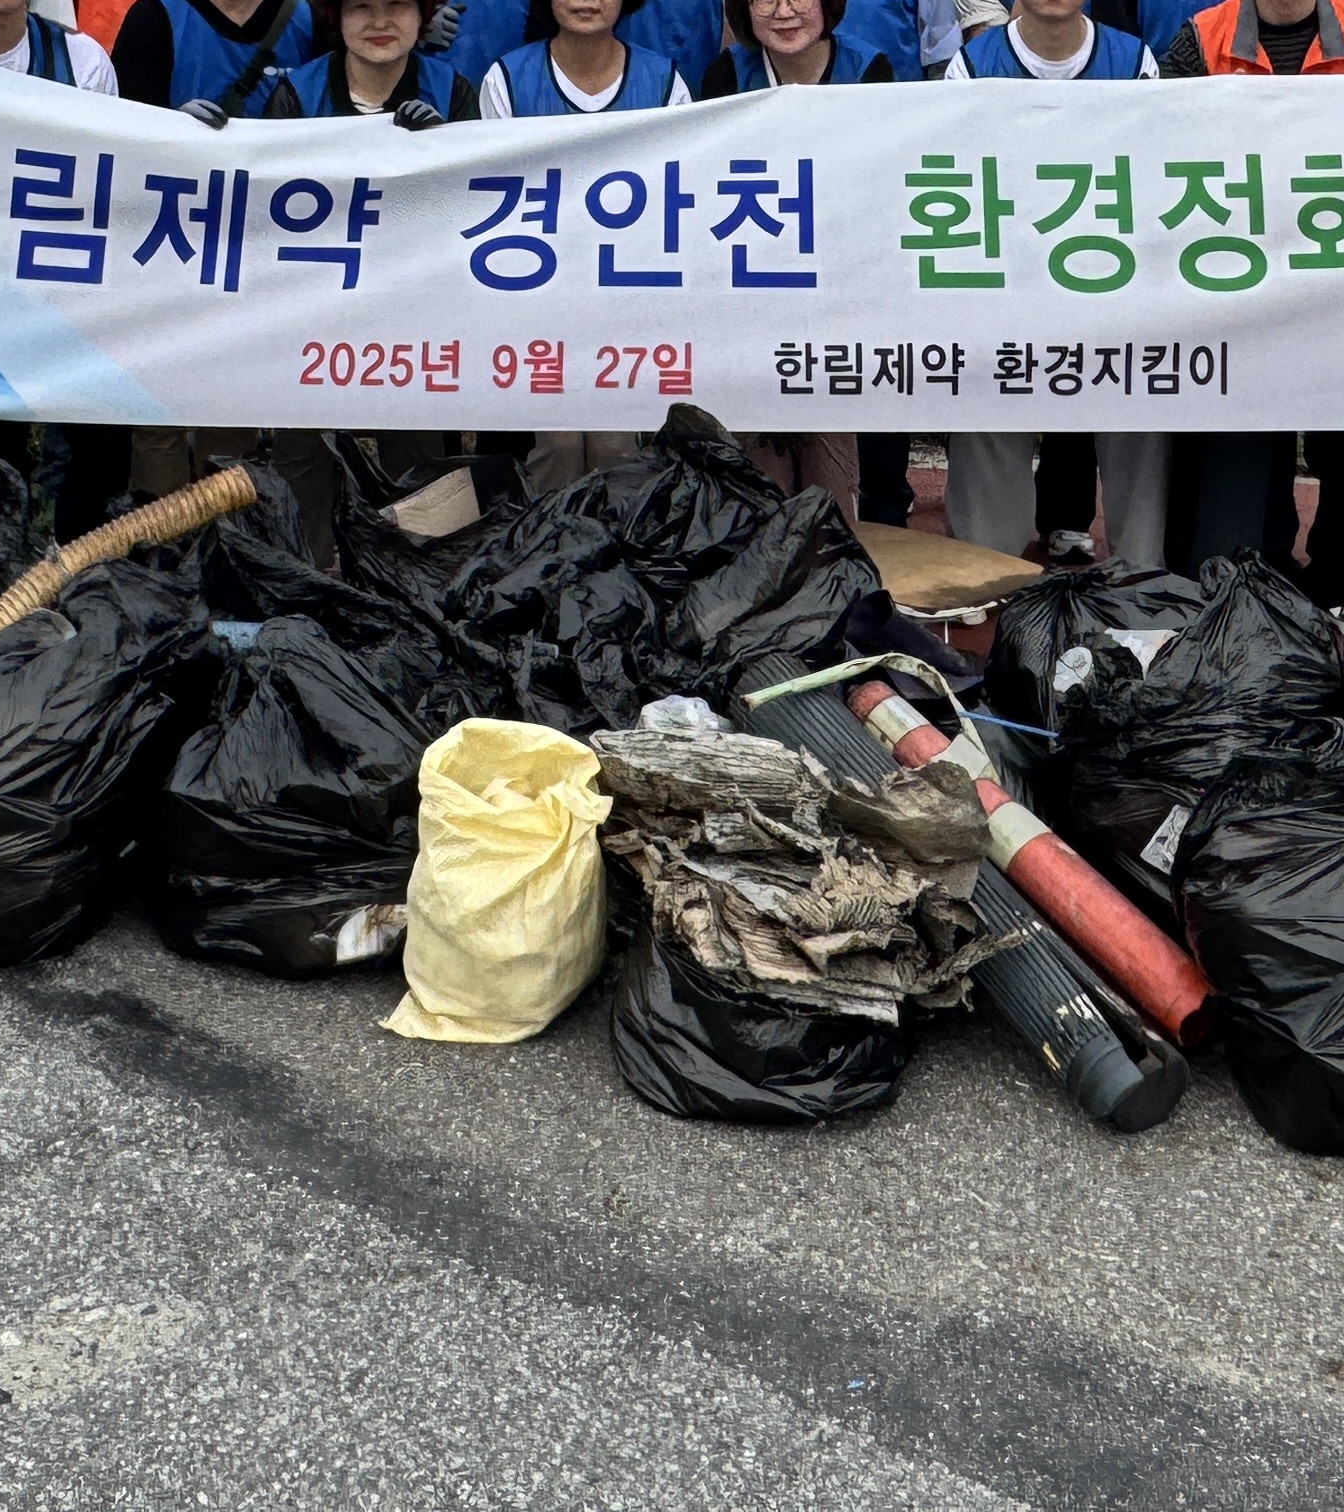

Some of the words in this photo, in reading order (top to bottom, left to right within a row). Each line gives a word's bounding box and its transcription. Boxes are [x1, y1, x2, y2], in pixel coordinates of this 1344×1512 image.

[459, 158, 818, 291] 경안천
[299, 339, 461, 393] 2025년
[492, 339, 565, 395] 9월
[594, 342, 693, 396] 27일
[773, 342, 966, 396] 한림제약
[993, 341, 1228, 396] 환경지킴이
